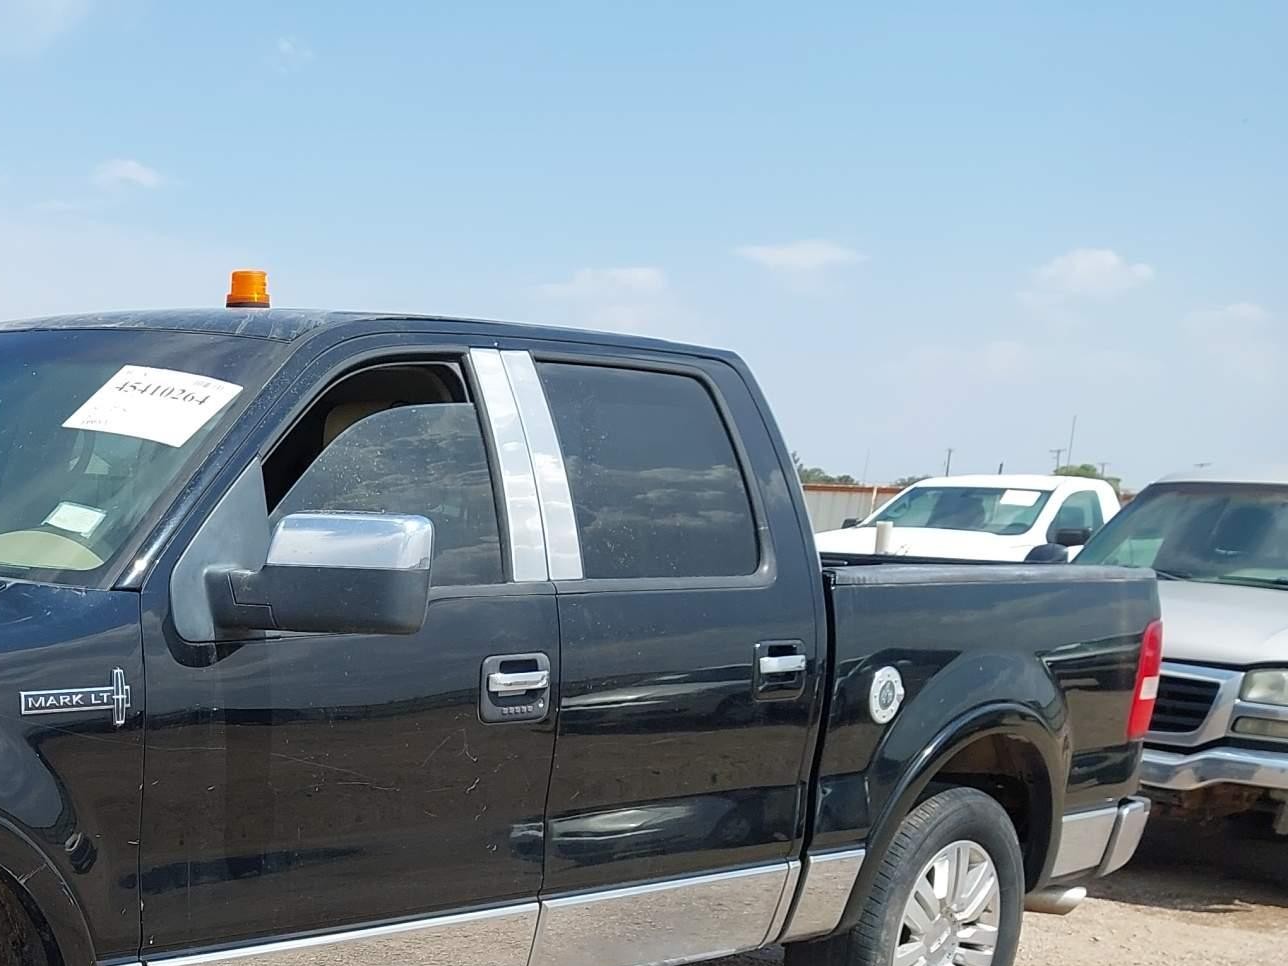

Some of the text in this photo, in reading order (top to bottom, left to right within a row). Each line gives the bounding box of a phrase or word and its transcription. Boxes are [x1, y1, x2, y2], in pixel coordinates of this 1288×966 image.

[114, 380, 211, 406] 45410264
[28, 692, 111, 708] MARK LT
